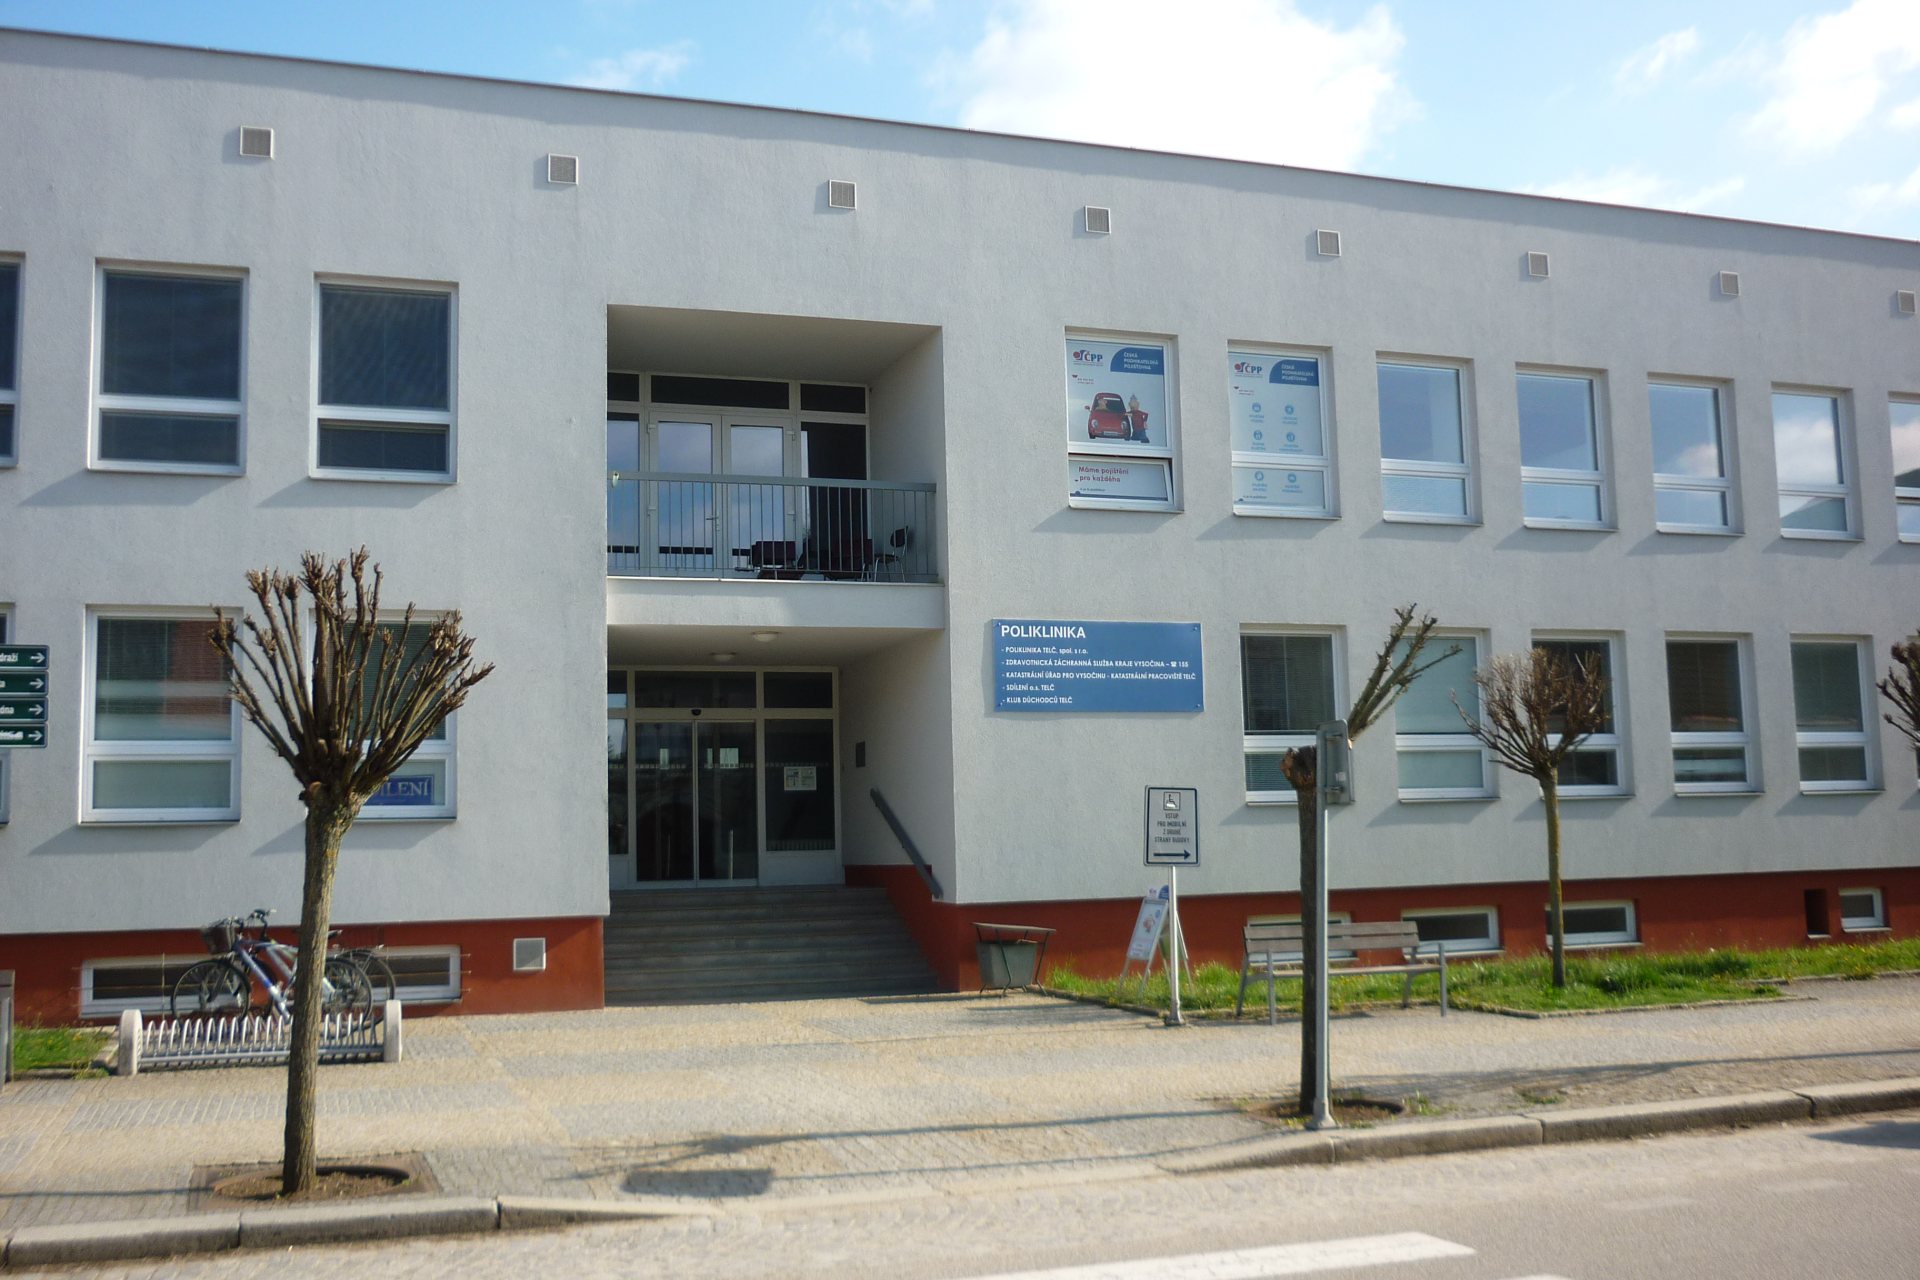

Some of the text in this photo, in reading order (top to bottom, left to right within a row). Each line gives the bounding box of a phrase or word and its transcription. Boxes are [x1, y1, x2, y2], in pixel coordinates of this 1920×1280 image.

[1084, 351, 1103, 362] ČPP
[1244, 363, 1263, 374] ČPP
[1078, 466, 1100, 474] Máme
[1092, 475, 1121, 483] každého
[1001, 625, 1086, 639] POLIKLINIKA
[1005, 658, 1053, 666] ZDRAVOTNICKÁ
[1054, 658, 1092, 667] ZÁCHRANNÁ
[1093, 659, 1114, 667] SLUŽBA
[1006, 670, 1044, 678] KATASTRÁLNÍ
[1045, 671, 1061, 679] ÚŘAD
[1006, 683, 1028, 691] SDÍLENÍ
[1041, 683, 1055, 691] TELČ
[1006, 696, 1073, 704] KLUB DŮCHODCŮ TELČ
